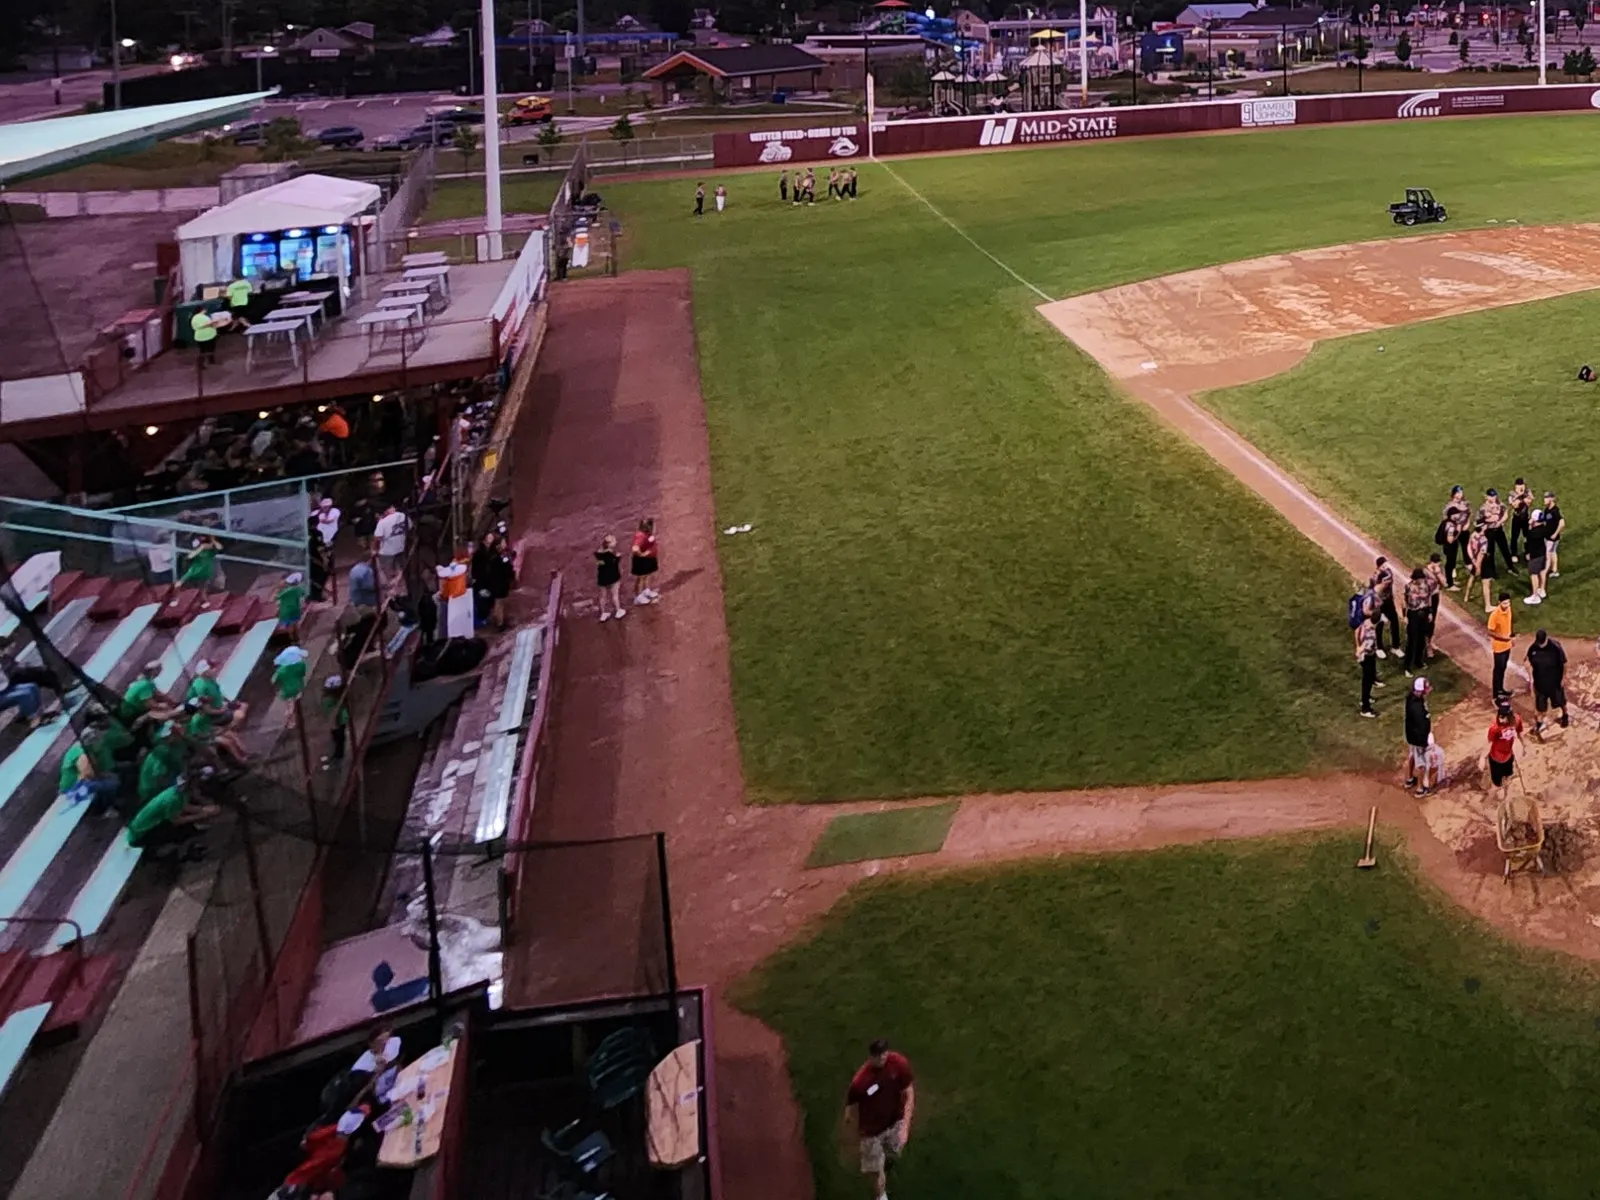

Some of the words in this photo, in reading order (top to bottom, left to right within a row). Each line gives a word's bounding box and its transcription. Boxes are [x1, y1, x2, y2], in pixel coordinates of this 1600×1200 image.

[1020, 116, 1117, 136] MID-STATE
[1020, 132, 1073, 143] TECHNICAL
[1077, 129, 1117, 139] COLLEGE
